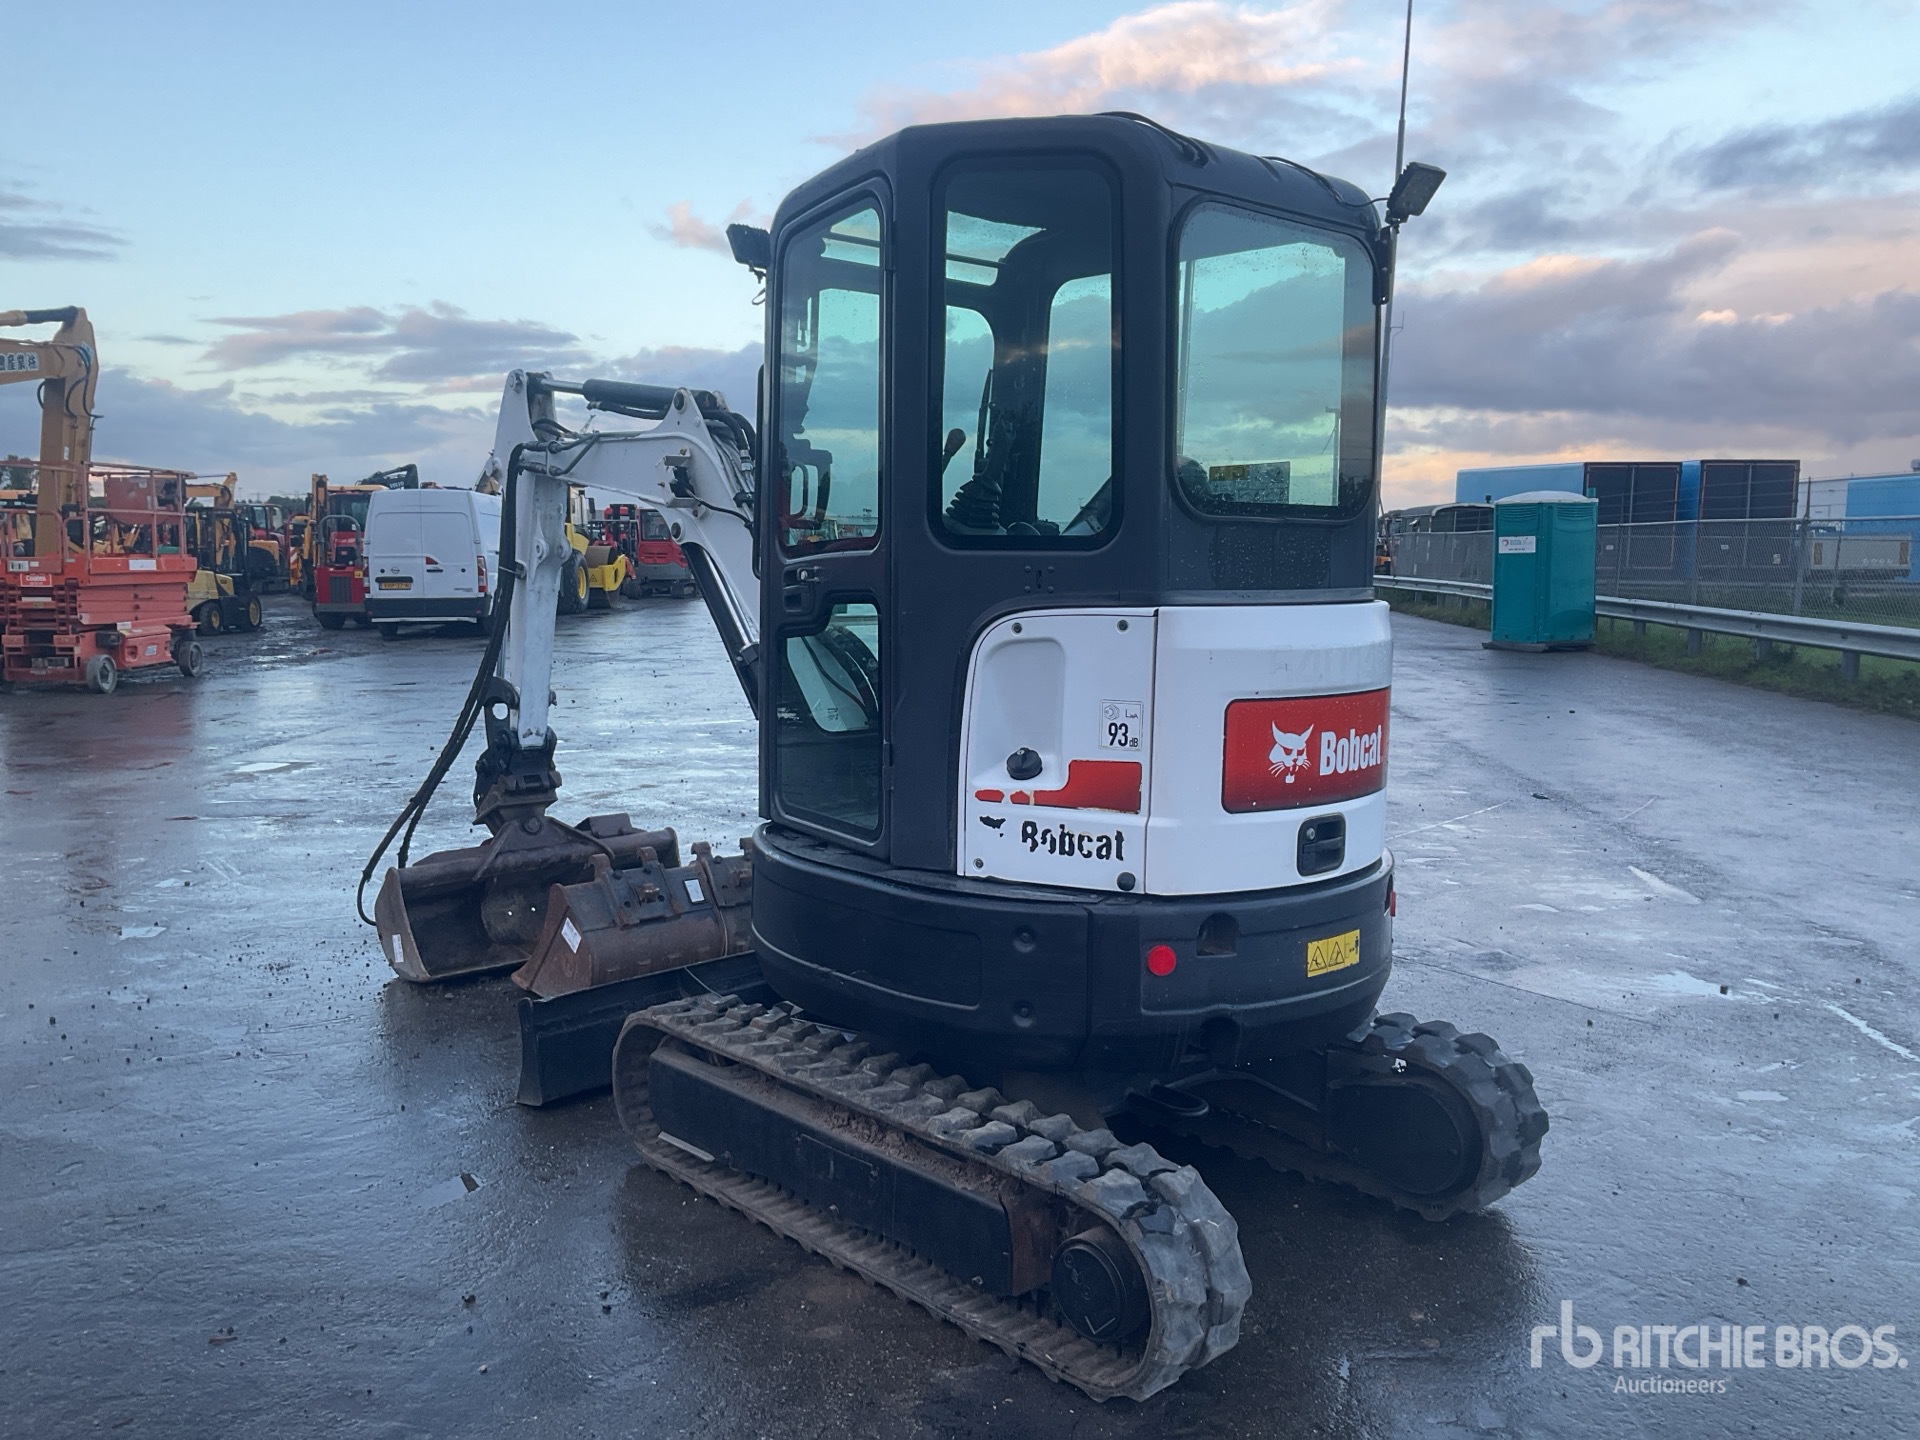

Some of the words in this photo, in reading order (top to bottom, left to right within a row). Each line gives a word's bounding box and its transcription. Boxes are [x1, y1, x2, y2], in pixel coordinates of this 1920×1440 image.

[1108, 722, 1129, 747] 93
[1129, 737, 1139, 748] dB
[1319, 724, 1382, 776] Bobcat
[1021, 820, 1125, 861] Bobcat
